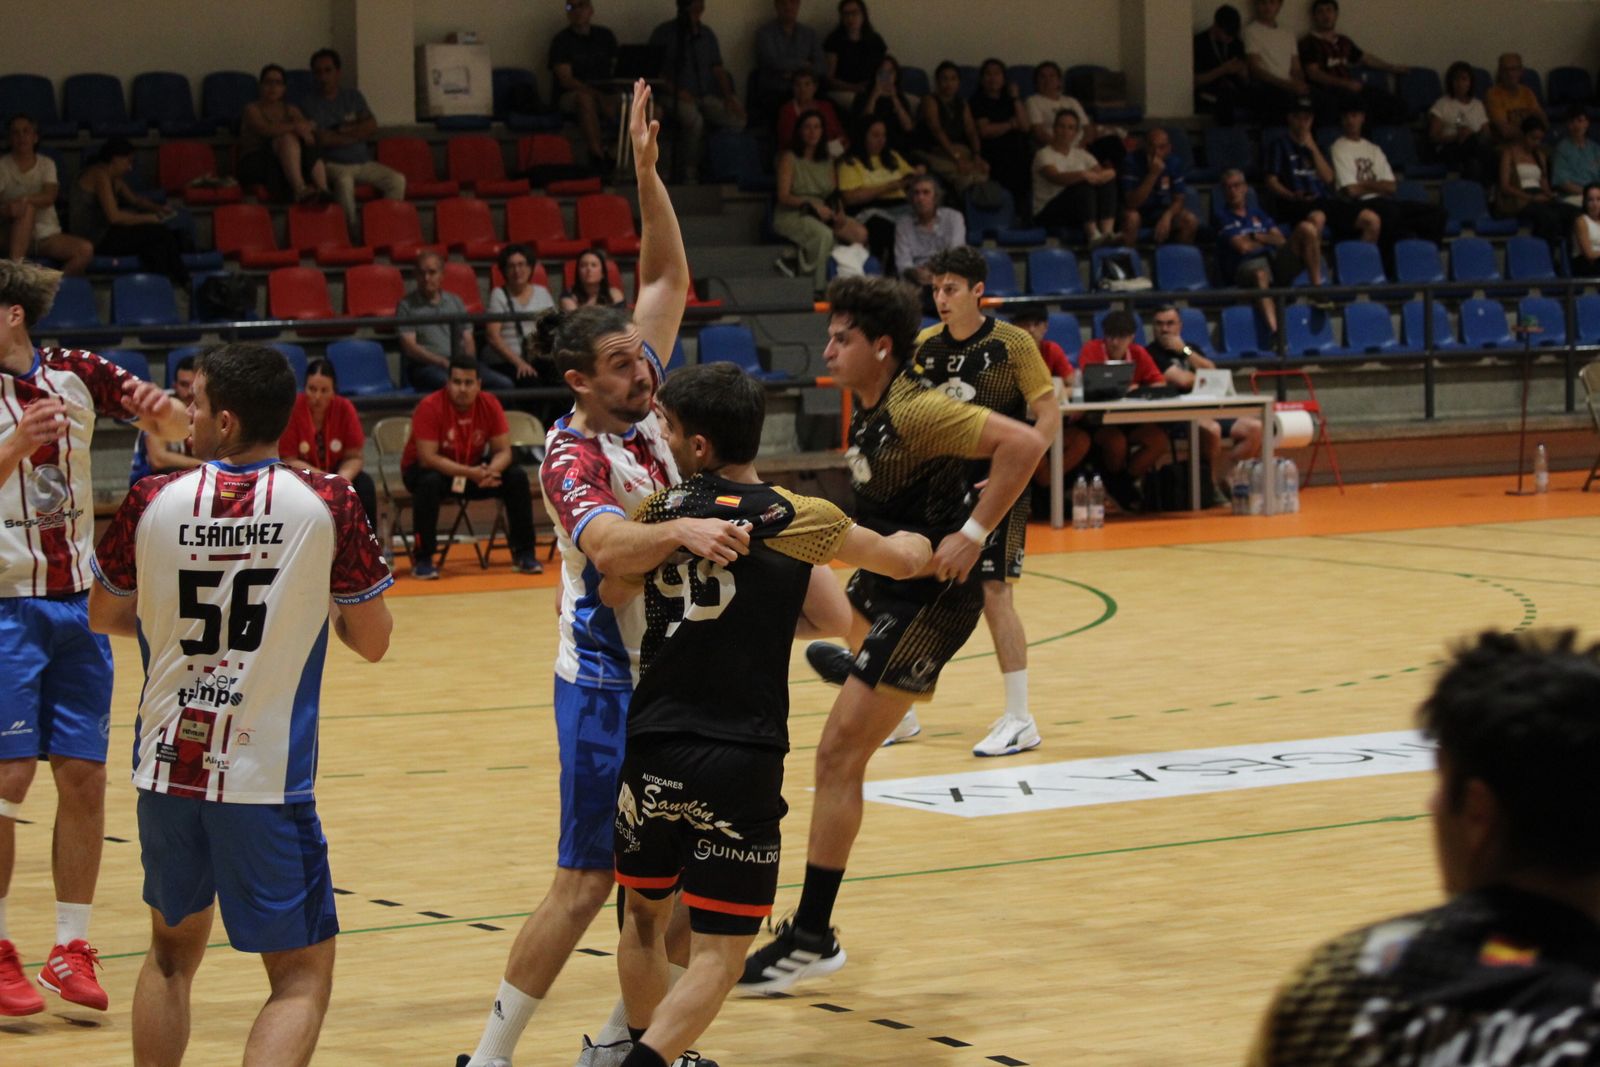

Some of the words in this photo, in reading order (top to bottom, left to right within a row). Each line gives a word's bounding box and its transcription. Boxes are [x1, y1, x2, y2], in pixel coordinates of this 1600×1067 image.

[946, 355, 966, 373] 27
[178, 521, 284, 547] C.SÁNCHEZ
[178, 567, 281, 656] 56
[641, 773, 684, 790] AUTOCARES
[694, 838, 779, 864] GUINALDO
